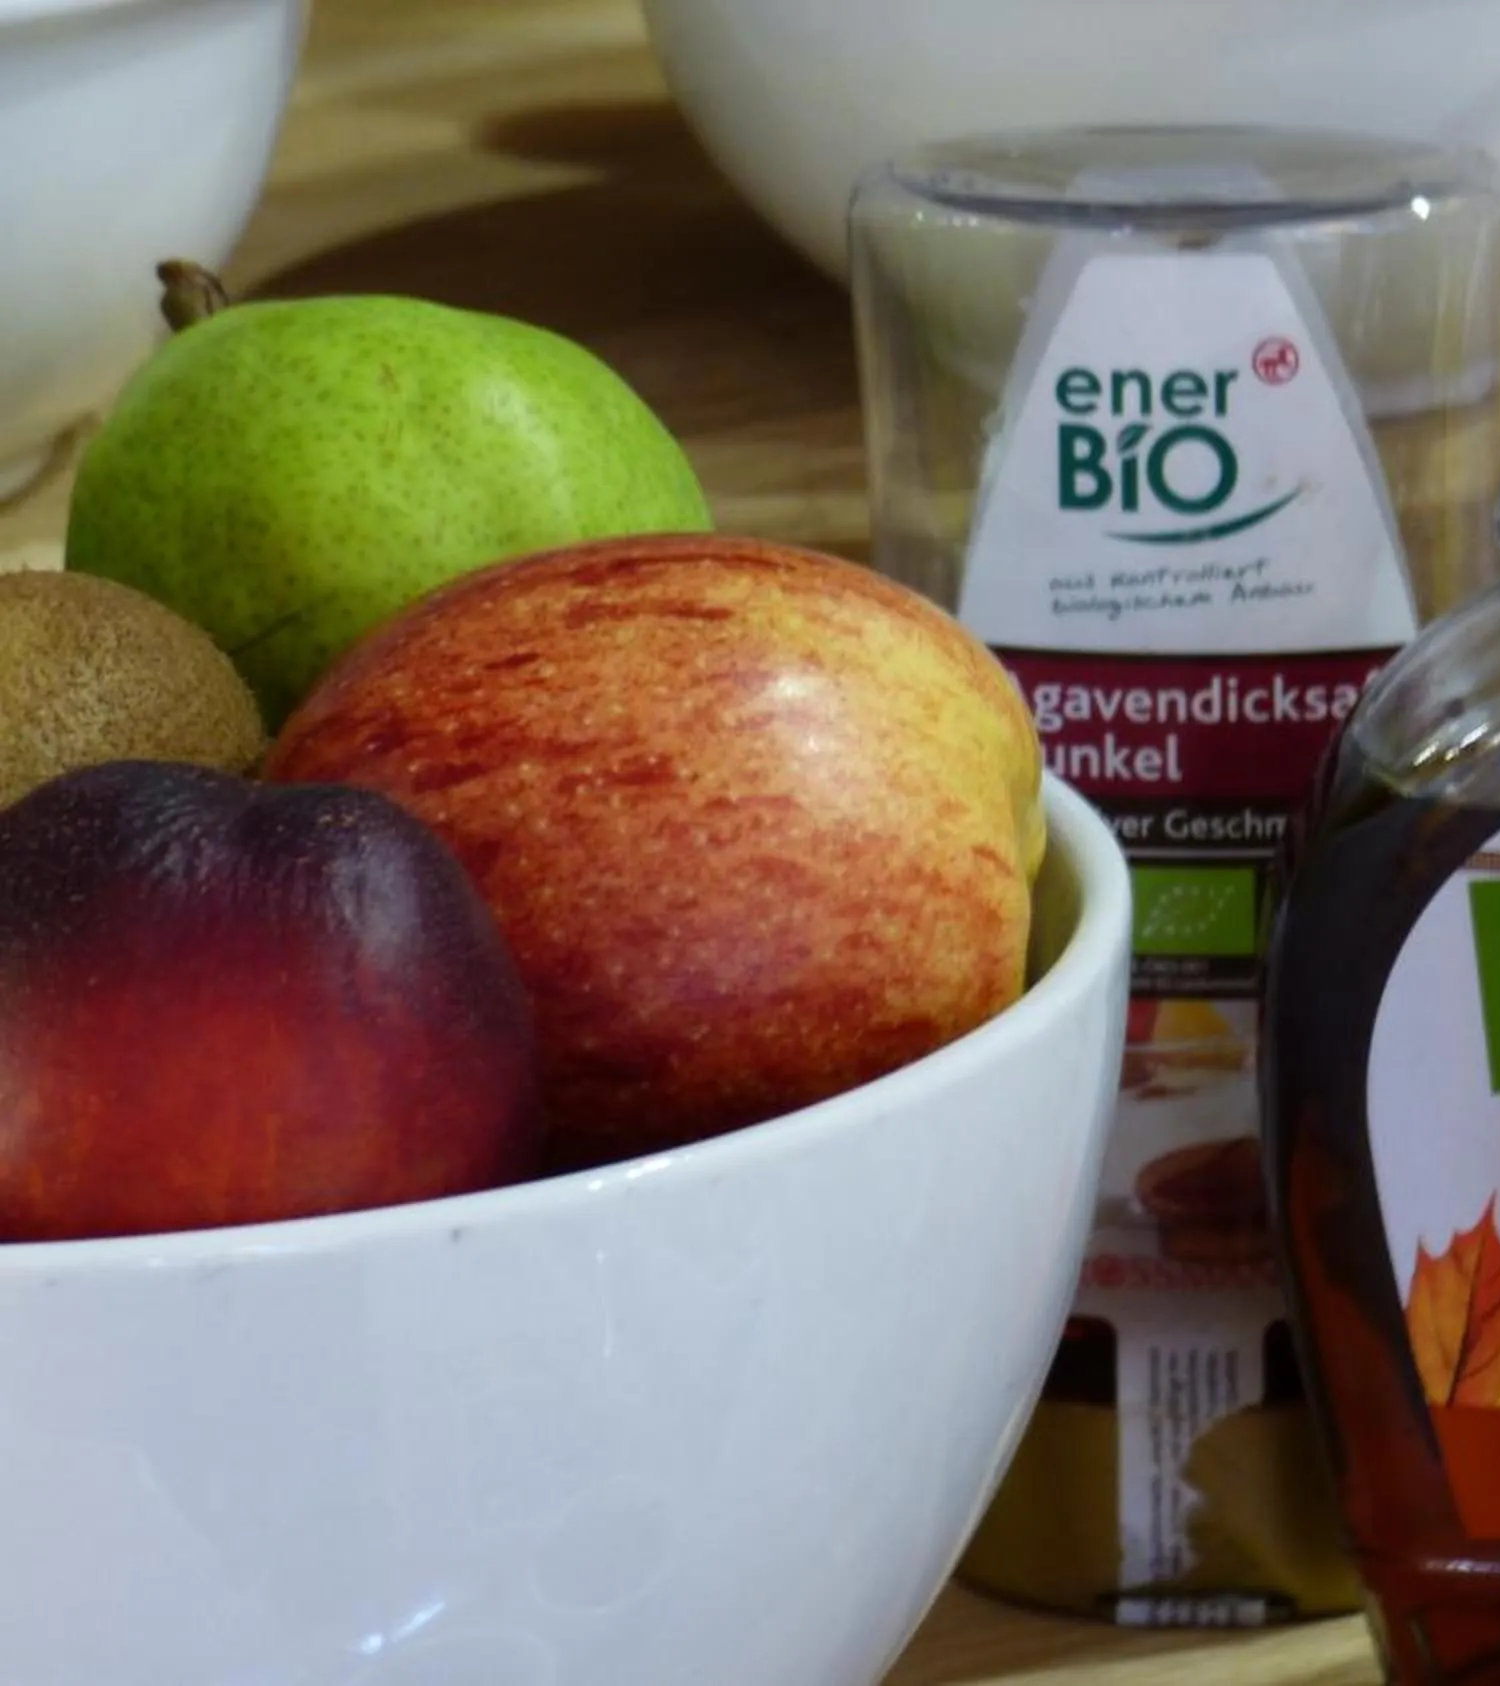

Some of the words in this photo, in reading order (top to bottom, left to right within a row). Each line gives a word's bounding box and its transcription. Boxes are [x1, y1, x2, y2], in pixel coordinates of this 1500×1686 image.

[1055, 367, 1239, 418] ener
[1006, 668, 1379, 732] gavendicksa
[1041, 733, 1182, 783] unkel
